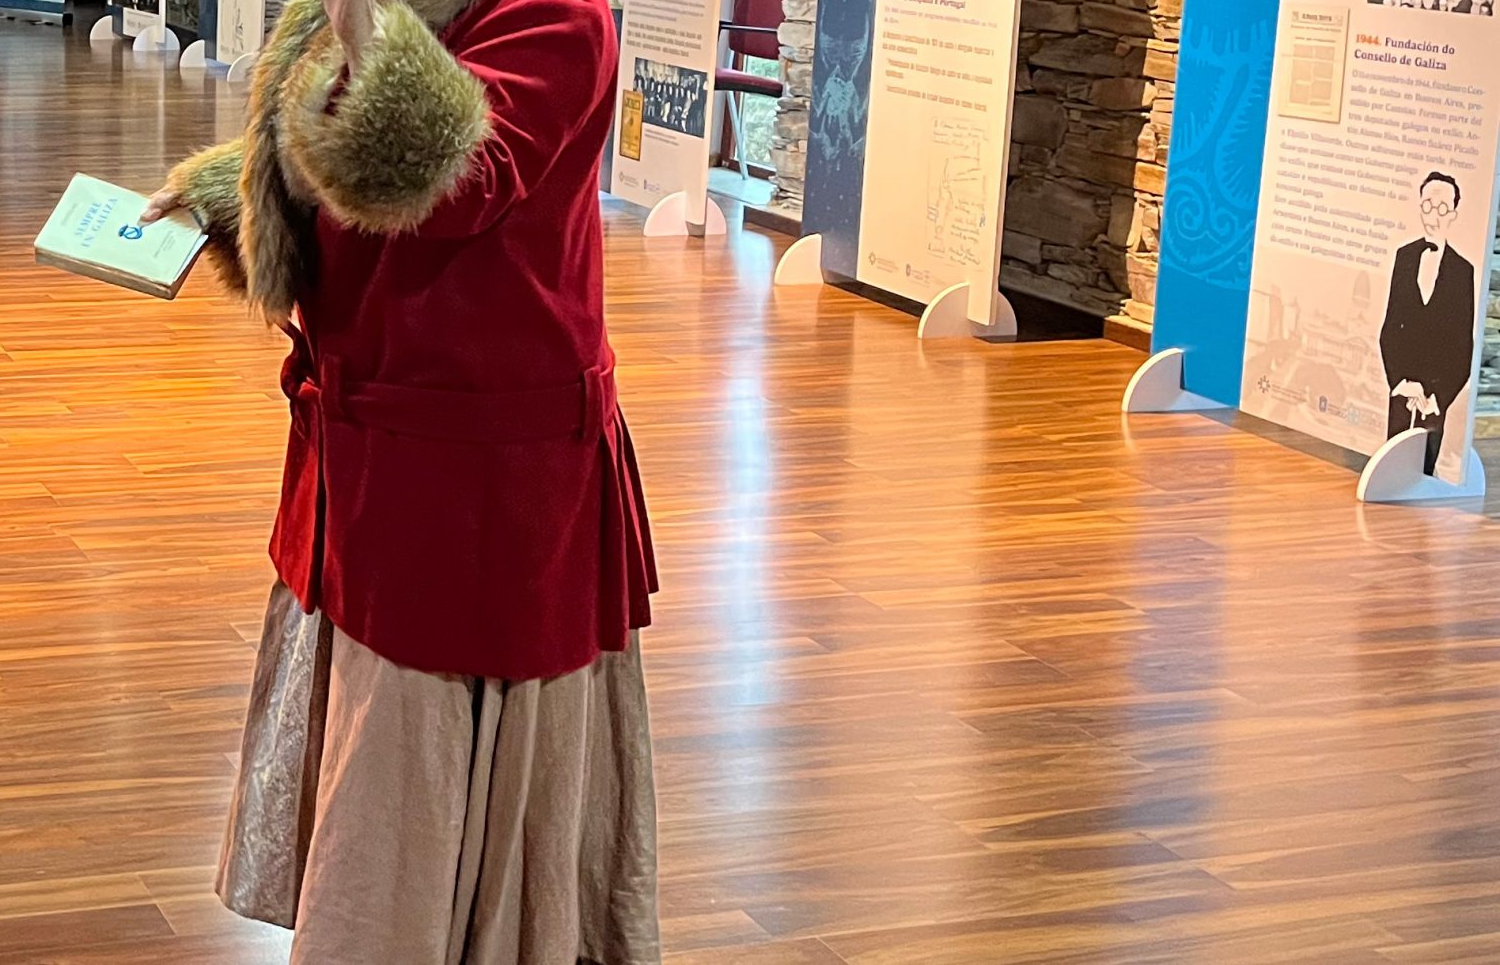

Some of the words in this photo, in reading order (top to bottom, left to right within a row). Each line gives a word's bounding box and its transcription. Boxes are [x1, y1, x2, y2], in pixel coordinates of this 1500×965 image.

[1356, 34, 1382, 46] 1944.
[1385, 37, 1439, 53] Fundación
[1442, 45, 1455, 55] do
[1354, 49, 1398, 64] Consello
[1399, 55, 1412, 66] de
[1414, 57, 1447, 71] Galiza
[74, 202, 102, 236] SEMPRE
[91, 198, 118, 232] GALIZA
